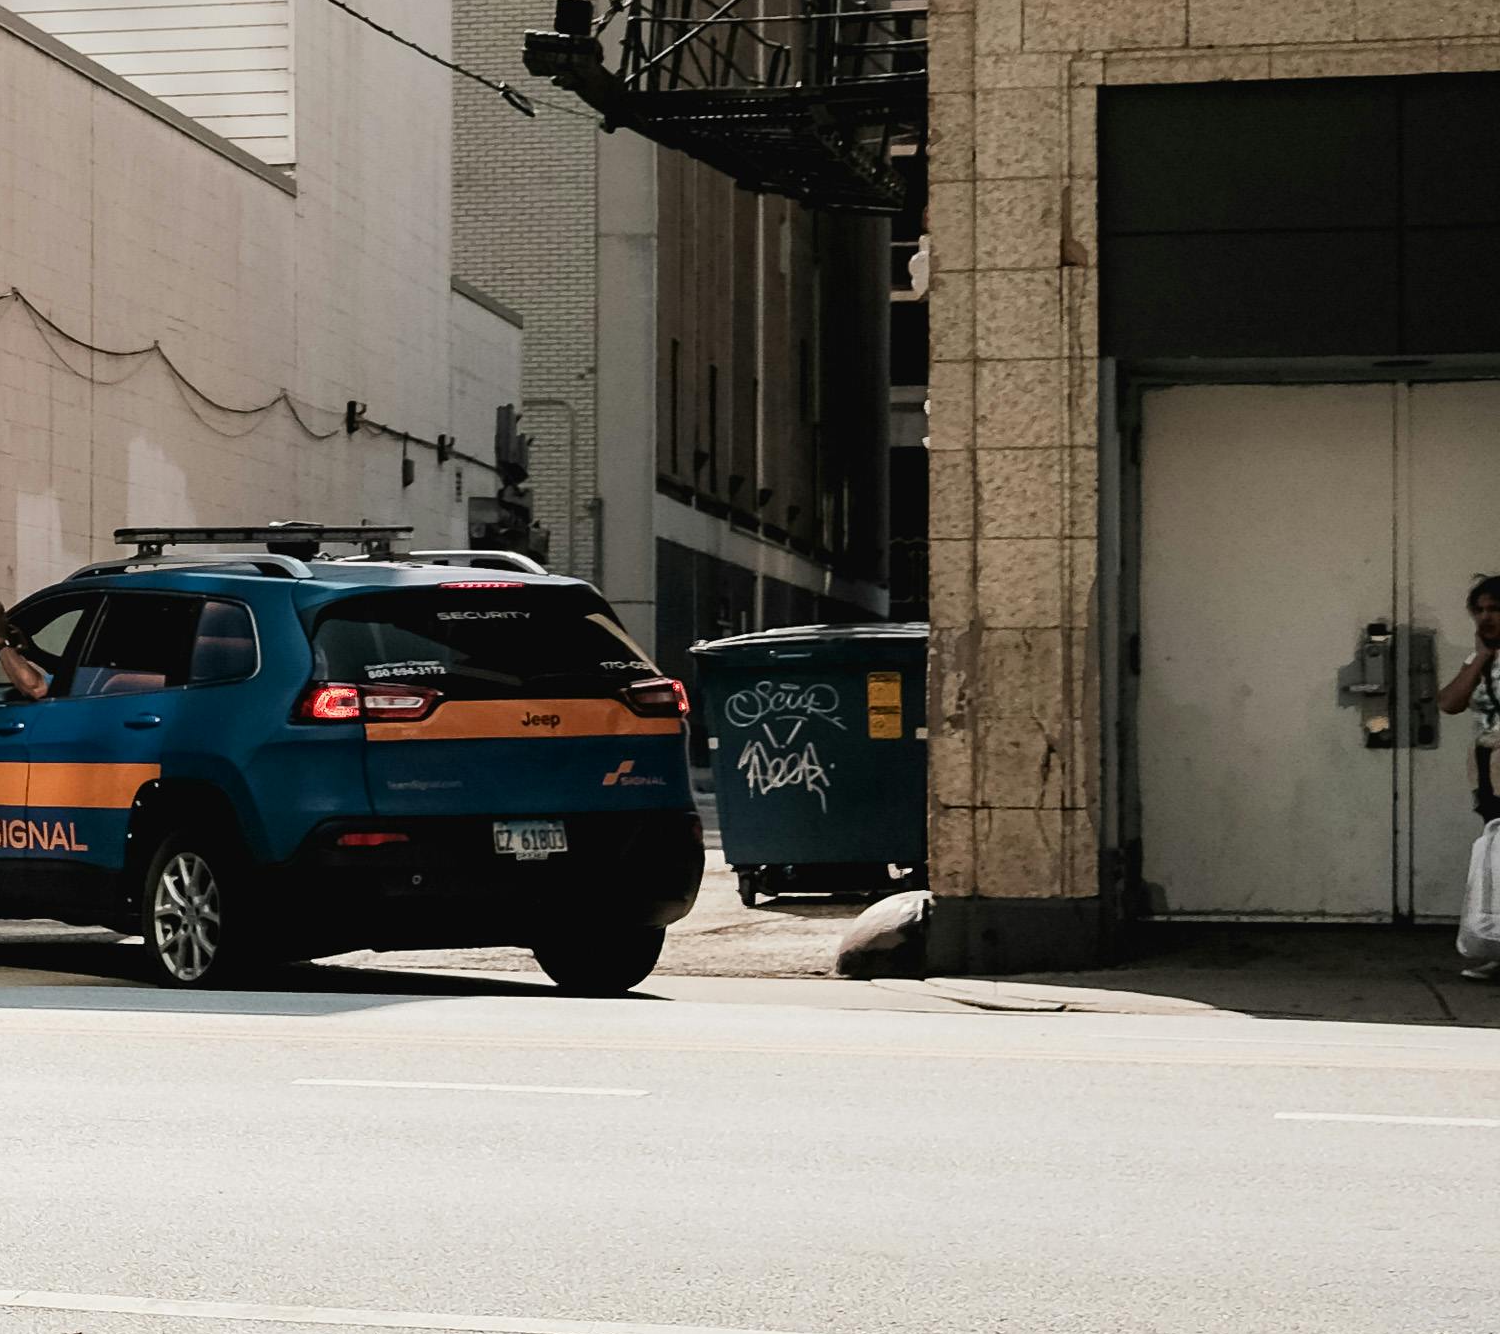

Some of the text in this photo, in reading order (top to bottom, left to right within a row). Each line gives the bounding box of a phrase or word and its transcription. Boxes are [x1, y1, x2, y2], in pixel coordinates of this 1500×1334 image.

[436, 611, 531, 621] SECURITY
[521, 712, 561, 728] Jeep
[620, 775, 667, 786] SIGNAL
[496, 829, 513, 851] CZ
